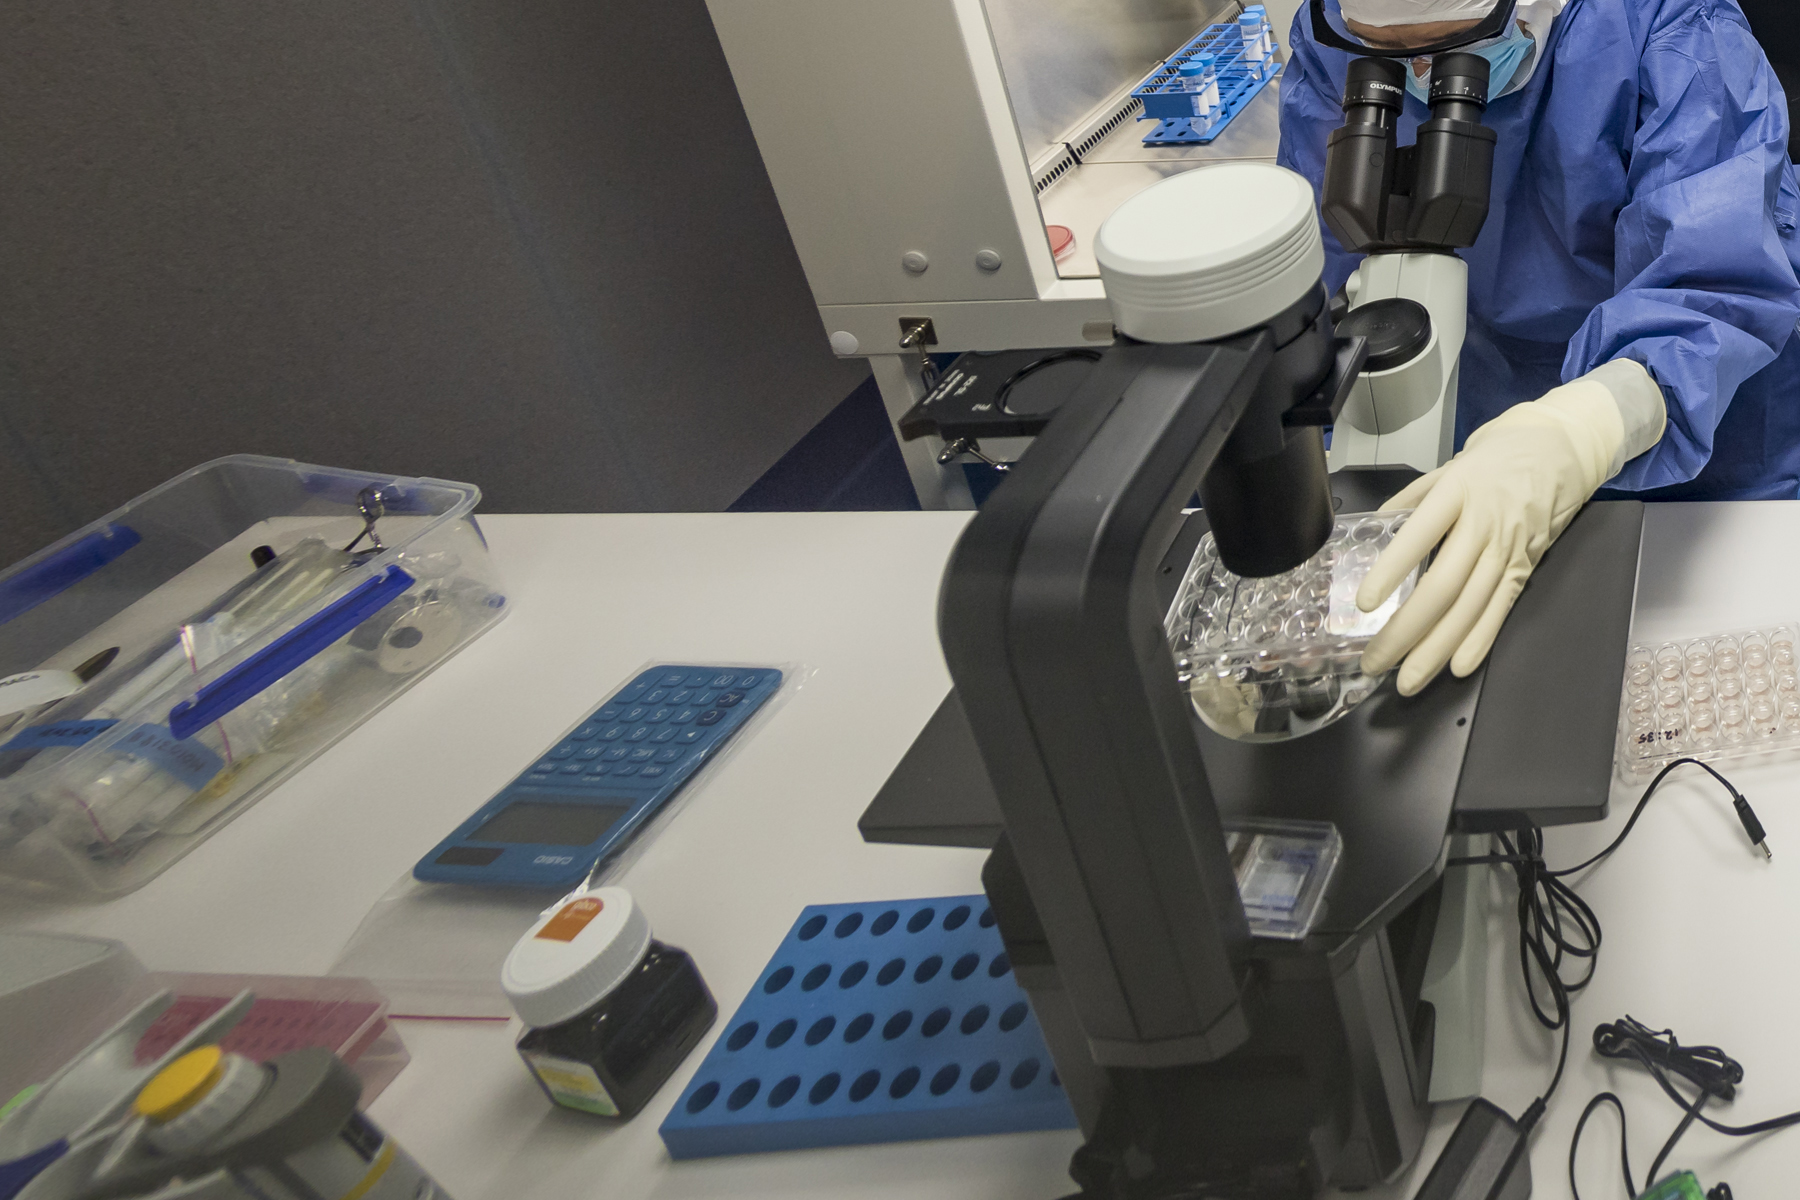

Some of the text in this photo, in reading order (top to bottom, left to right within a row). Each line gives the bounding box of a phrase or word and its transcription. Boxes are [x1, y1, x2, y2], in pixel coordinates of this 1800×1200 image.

[1370, 83, 1402, 95] OLYMPUS
[647, 689, 662, 701] 3
[672, 690, 688, 701] 2
[652, 708, 667, 720] 5
[677, 709, 691, 720] 4
[631, 727, 646, 739] 8
[1637, 728, 1679, 744] 12:35
[533, 855, 574, 865] CASIO
